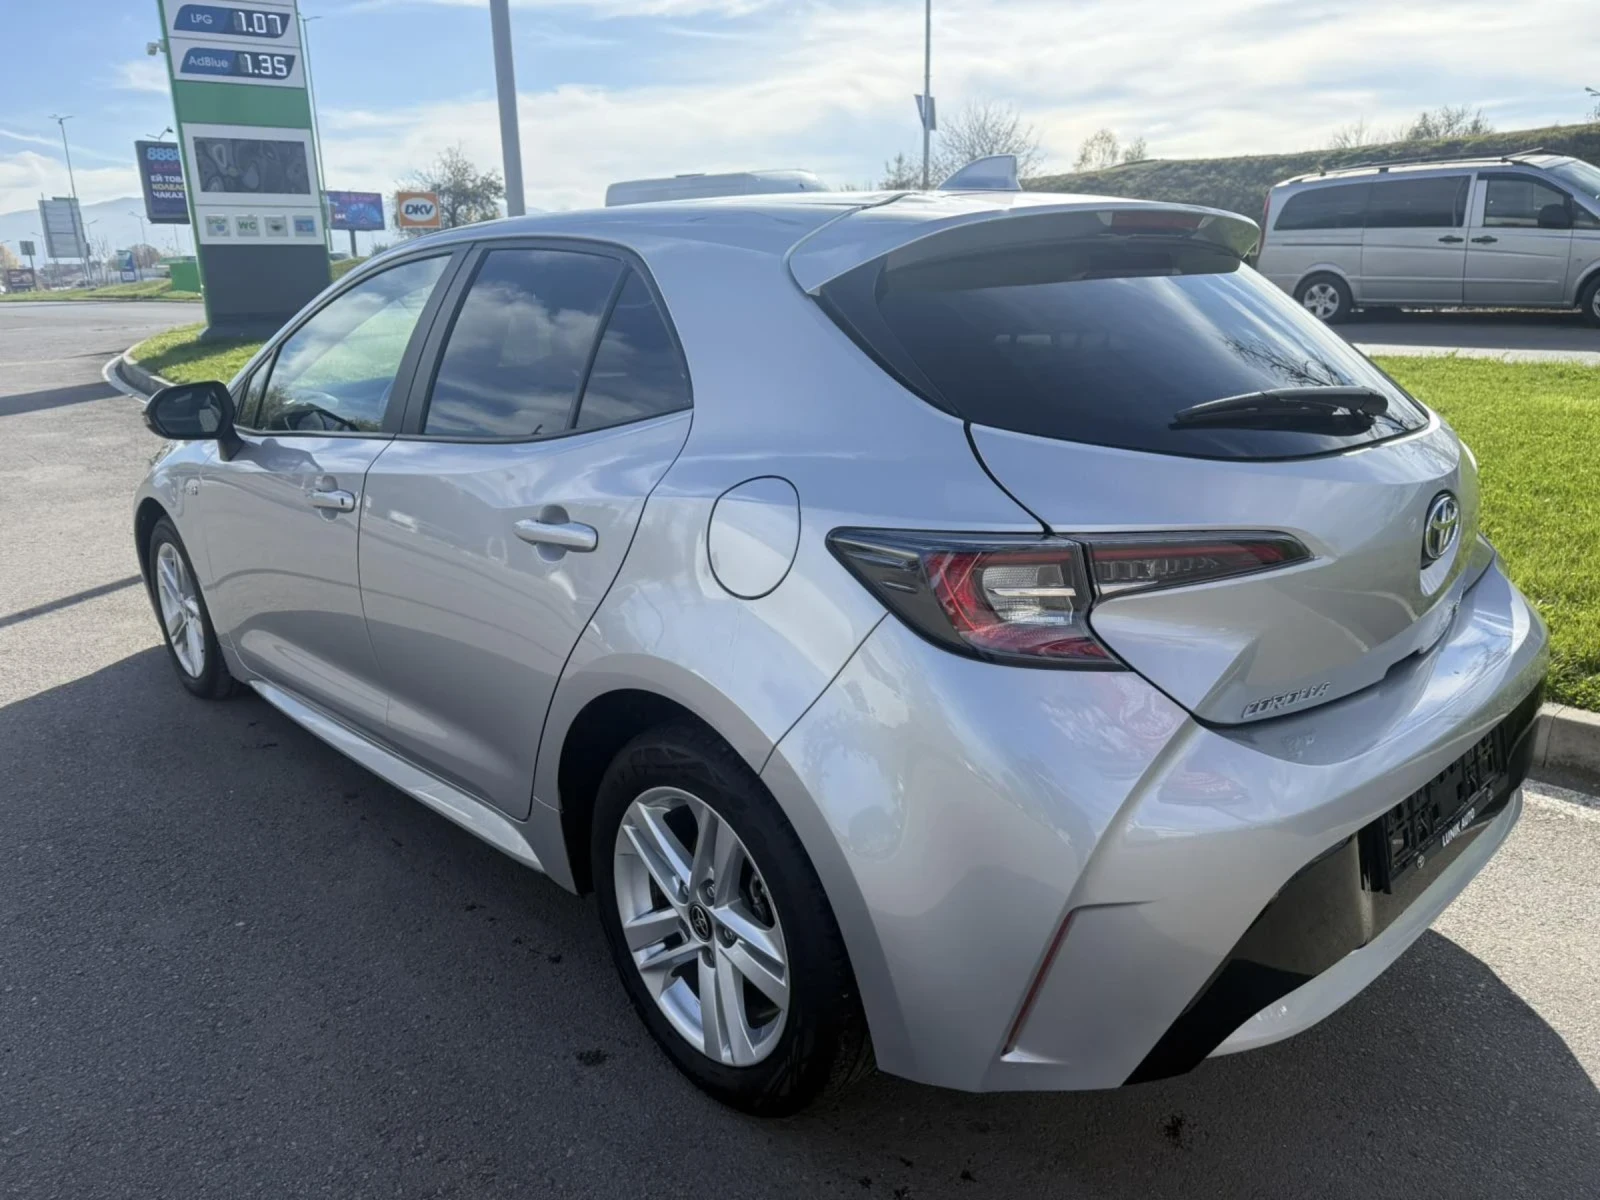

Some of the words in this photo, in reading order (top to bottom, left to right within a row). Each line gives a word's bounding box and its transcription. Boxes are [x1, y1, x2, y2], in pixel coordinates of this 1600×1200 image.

[190, 13, 213, 25] LPG
[238, 11, 282, 35] 1.07
[188, 55, 229, 68] AdBlue
[244, 53, 288, 77] 1.35
[404, 203, 434, 216] DKV
[239, 221, 257, 231] WC
